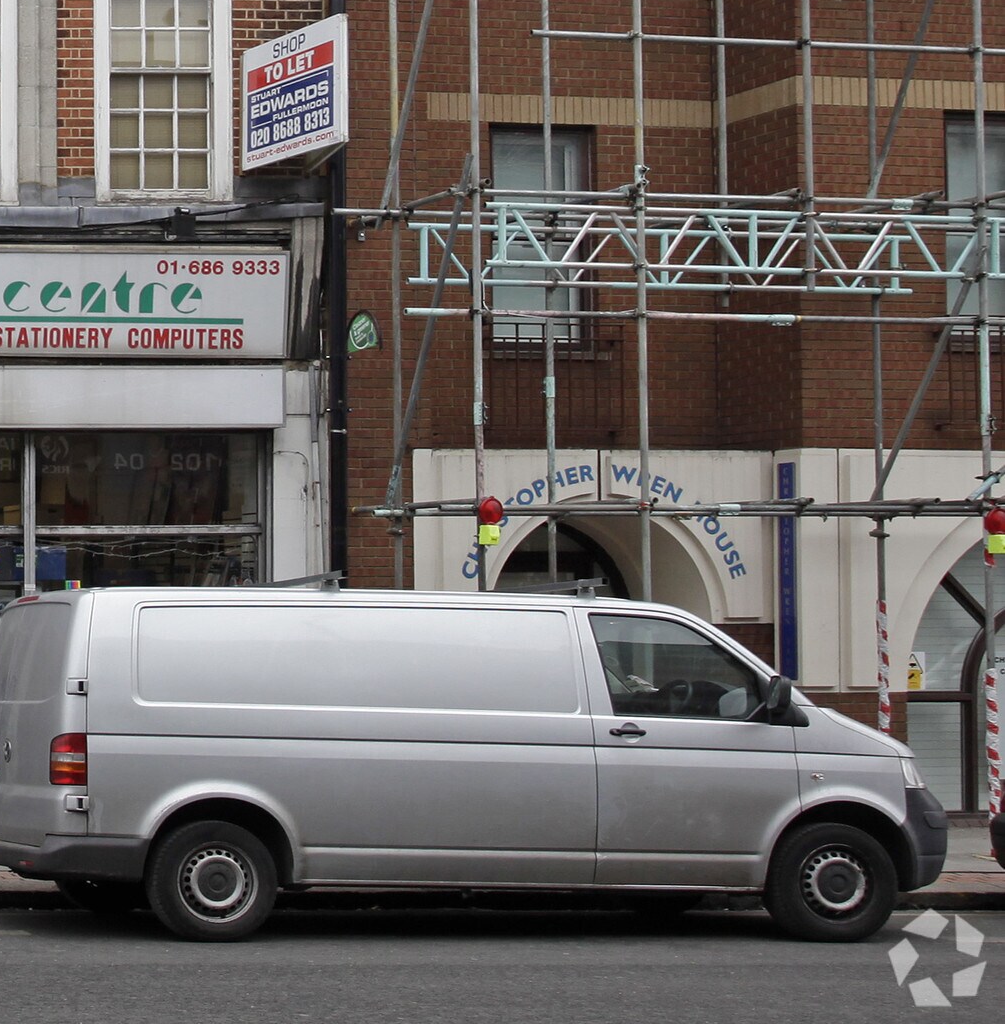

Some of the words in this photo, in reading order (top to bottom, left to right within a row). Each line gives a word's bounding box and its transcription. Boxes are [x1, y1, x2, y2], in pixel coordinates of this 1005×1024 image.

[273, 33, 306, 59] SHOP
[264, 62, 283, 83] TO
[287, 50, 315, 76] LET
[250, 80, 329, 119] EDWARDS
[251, 86, 283, 104] STUART
[272, 97, 329, 122] FULLERMOON
[250, 127, 270, 148] 020
[273, 116, 301, 142] 8688
[304, 107, 330, 132] 8313
[247, 130, 335, 163] stuart-edwards.com
[232, 260, 281, 275] 9333
[3, 270, 203, 314] centre
[128, 327, 244, 350] COMPUTERS
